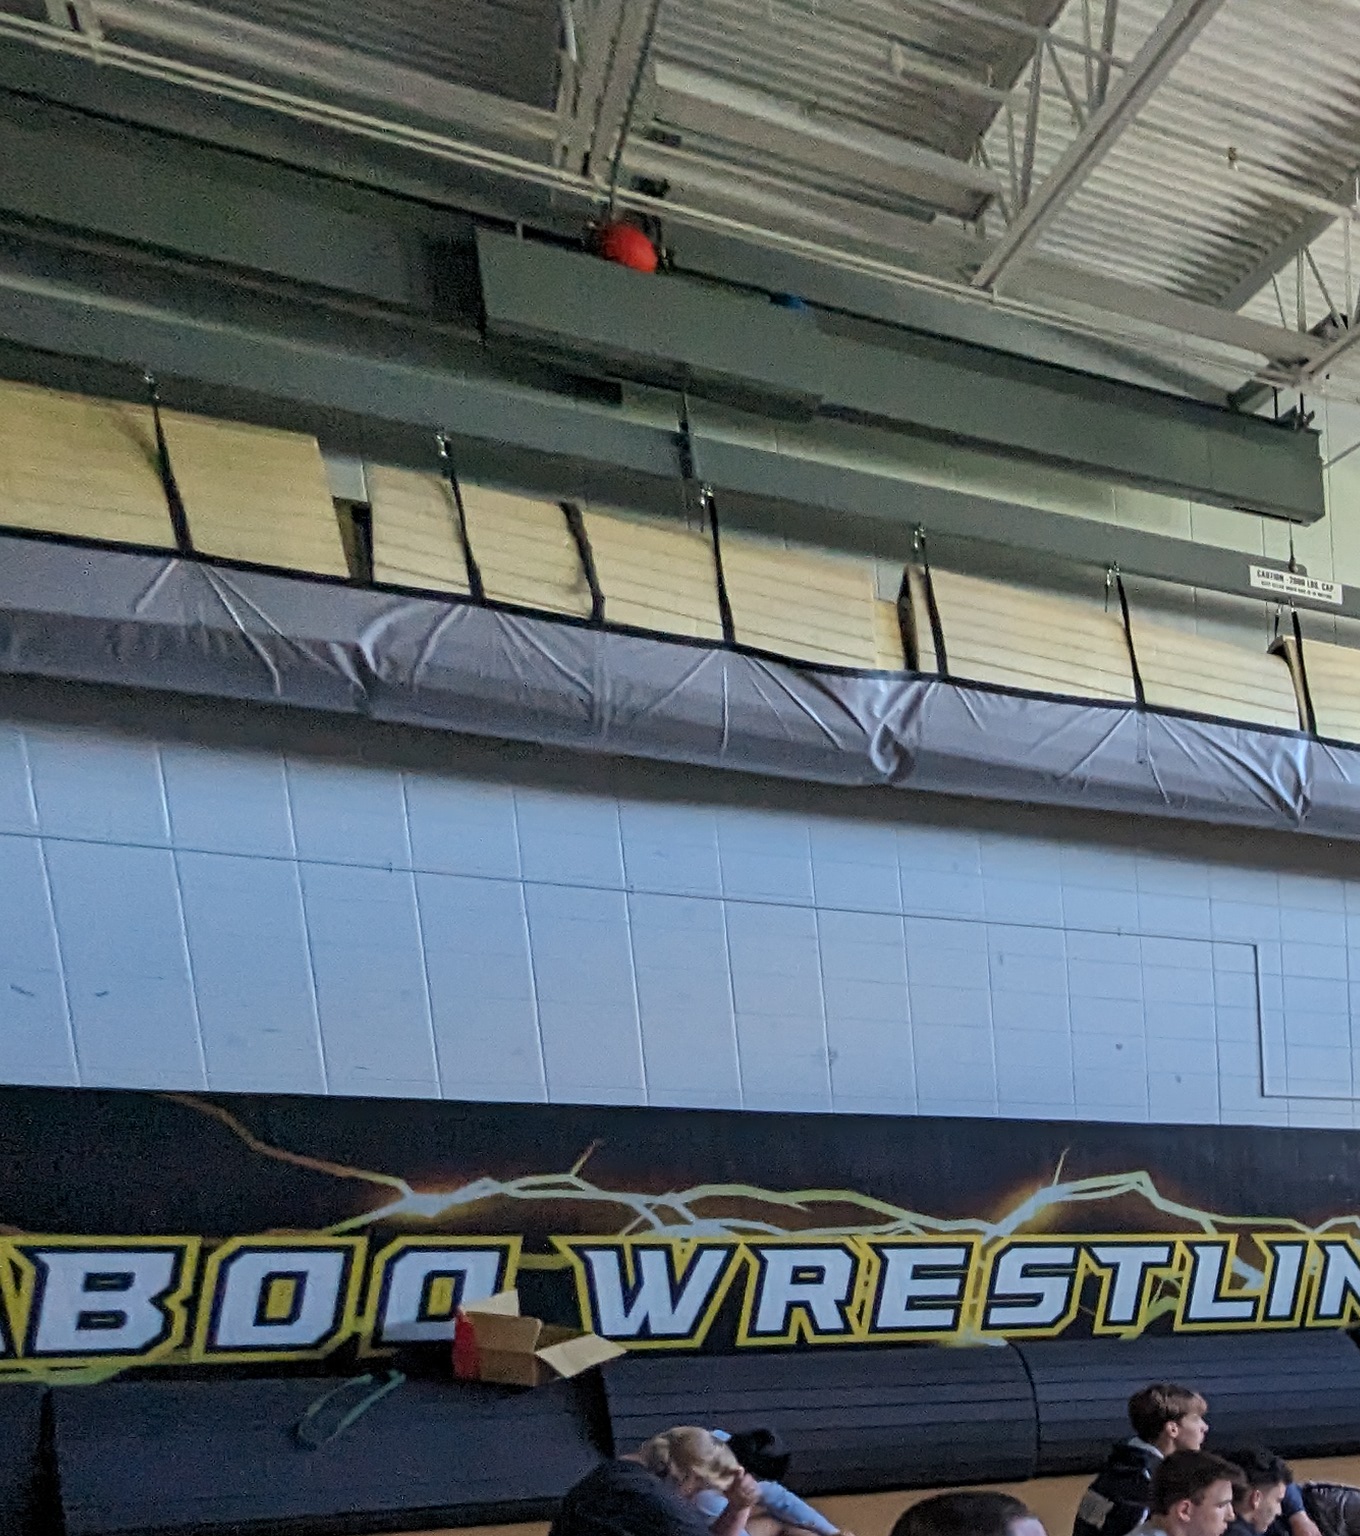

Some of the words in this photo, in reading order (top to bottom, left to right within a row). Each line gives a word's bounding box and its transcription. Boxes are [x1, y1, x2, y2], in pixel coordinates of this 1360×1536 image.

[1257, 569, 1284, 582] CAUTION
[1321, 583, 1335, 593] CAP
[0, 1235, 521, 1365] BOO
